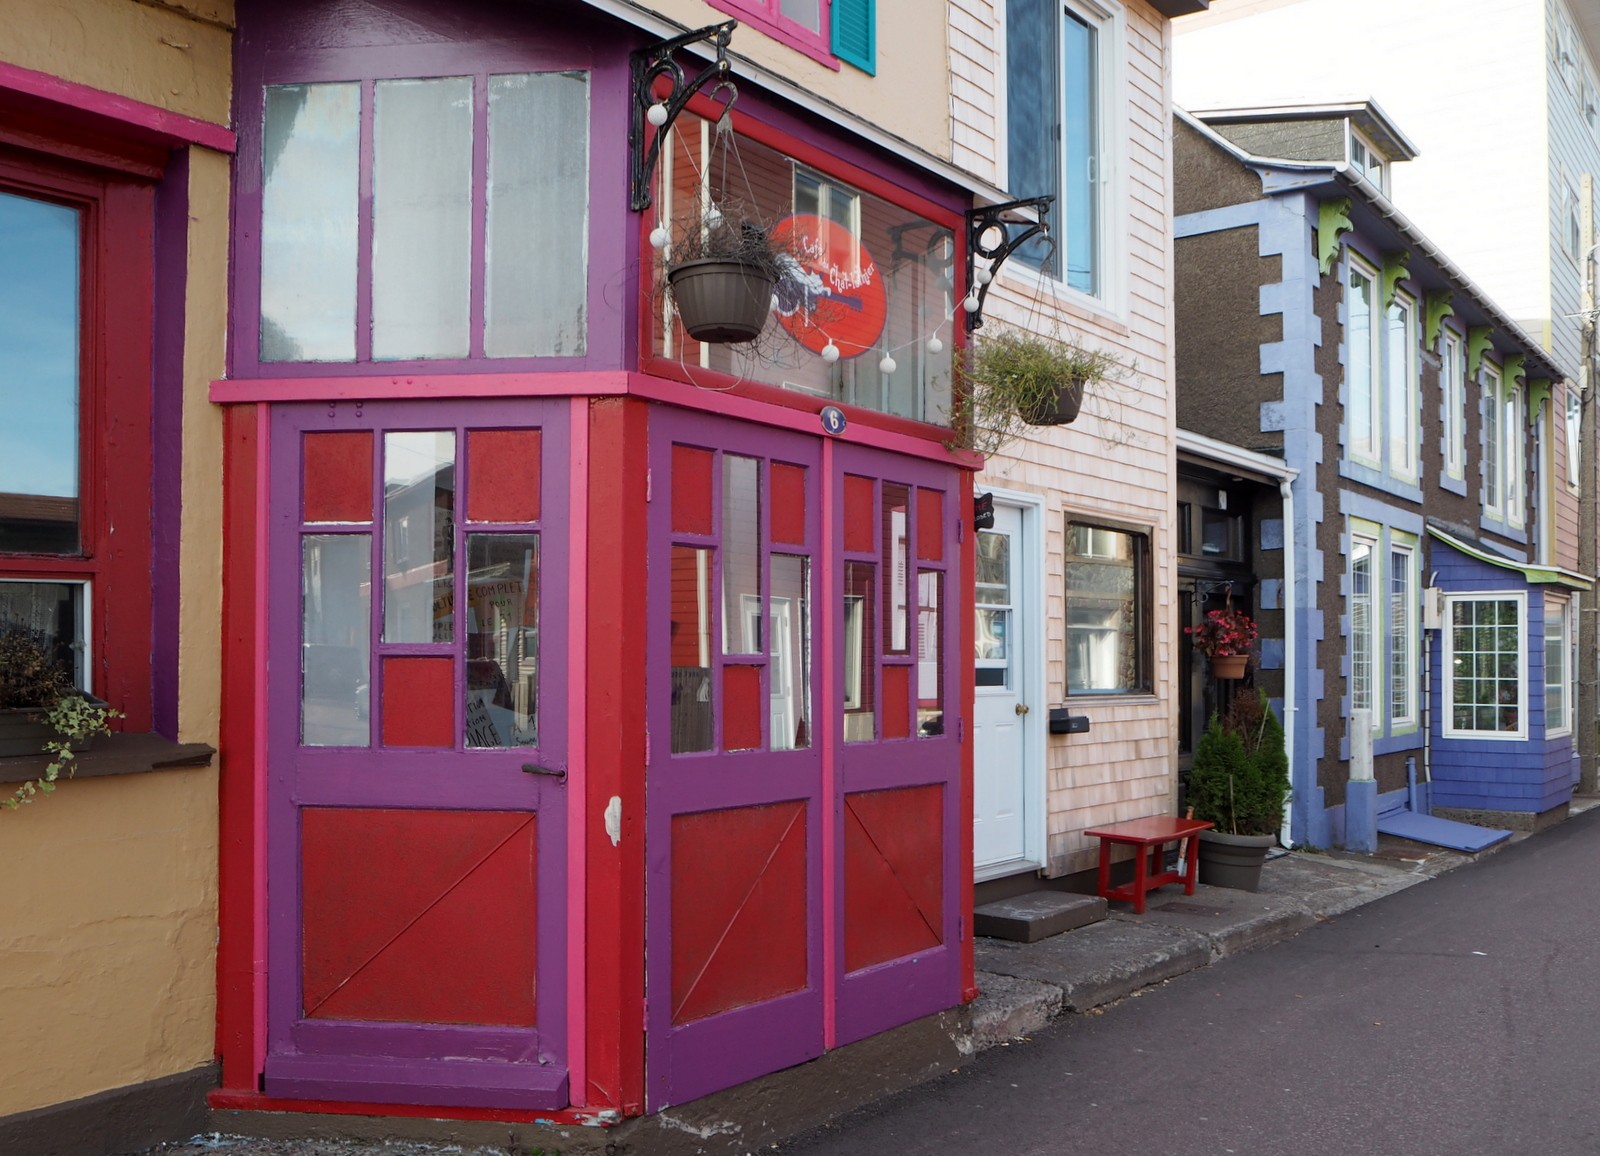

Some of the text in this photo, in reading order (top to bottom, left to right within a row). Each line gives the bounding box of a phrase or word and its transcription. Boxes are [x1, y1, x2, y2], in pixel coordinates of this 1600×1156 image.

[829, 410, 839, 430] 6
[475, 581, 522, 598] COMPLET
[489, 598, 513, 608] POUR
